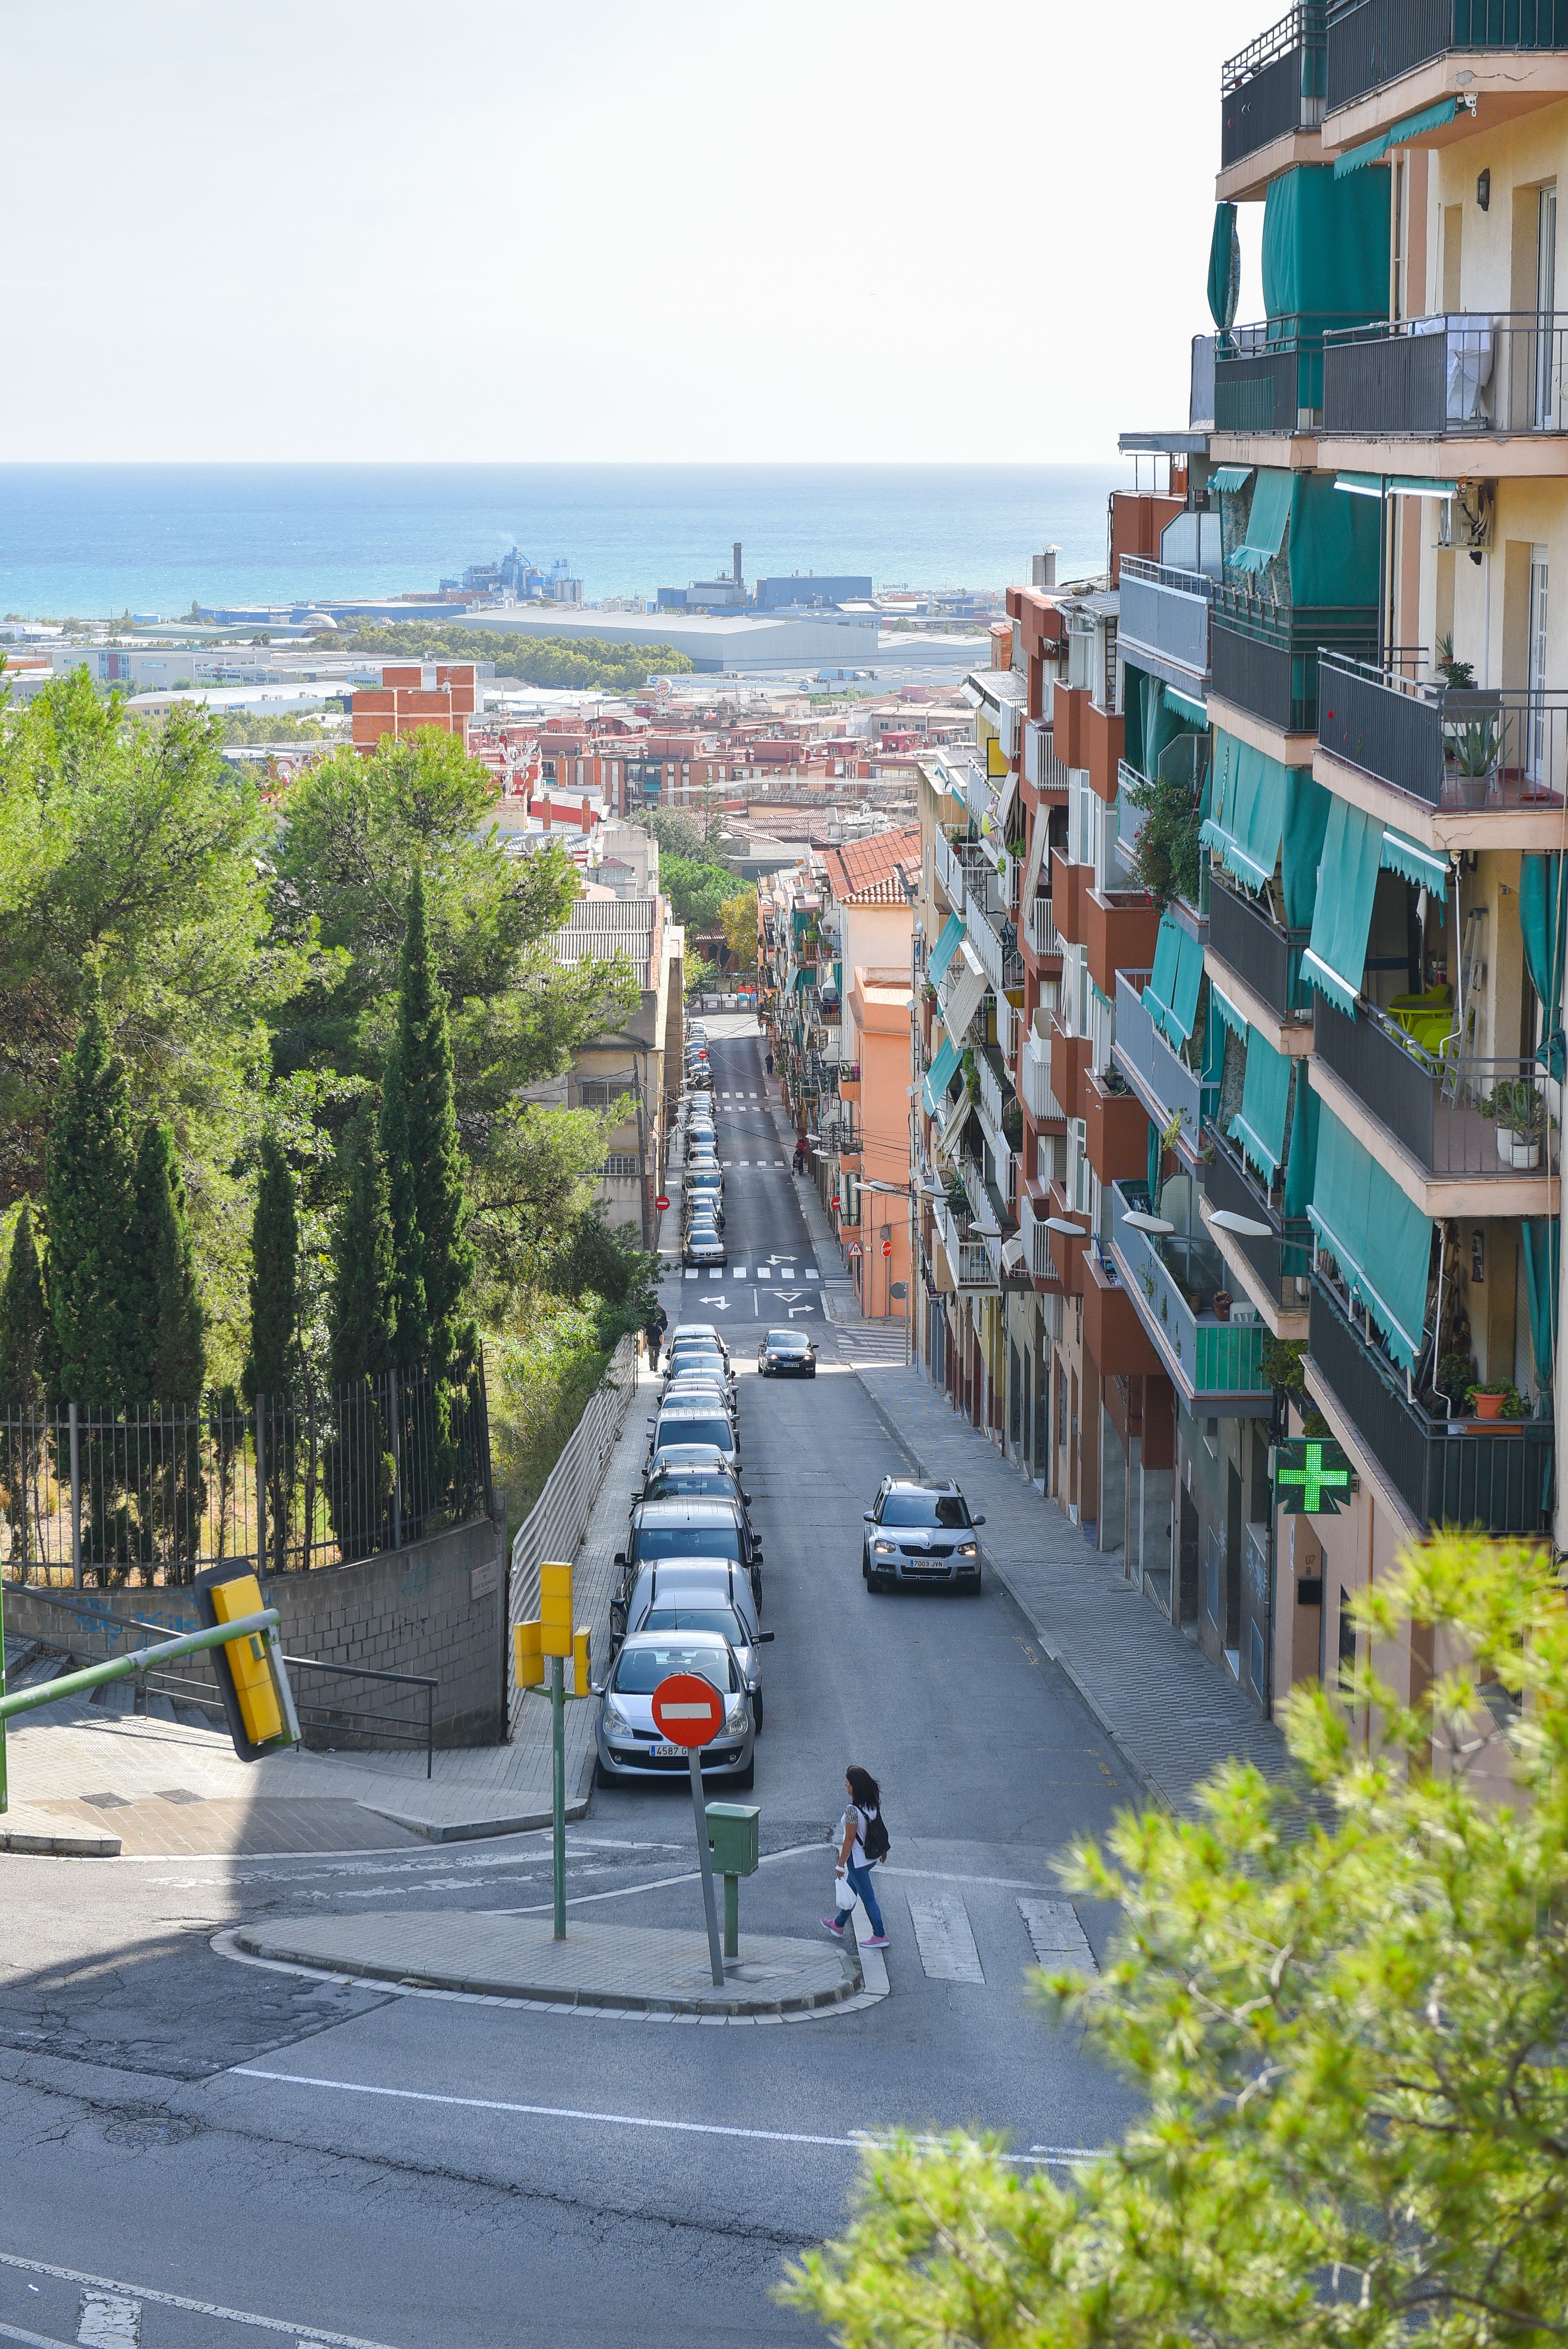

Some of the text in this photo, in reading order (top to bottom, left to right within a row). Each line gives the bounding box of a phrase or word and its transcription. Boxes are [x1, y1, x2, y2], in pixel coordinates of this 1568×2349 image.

[1305, 1555, 1315, 1565] 07
[479, 1565, 491, 1574] CARRER
[657, 1747, 679, 1755] 4587
